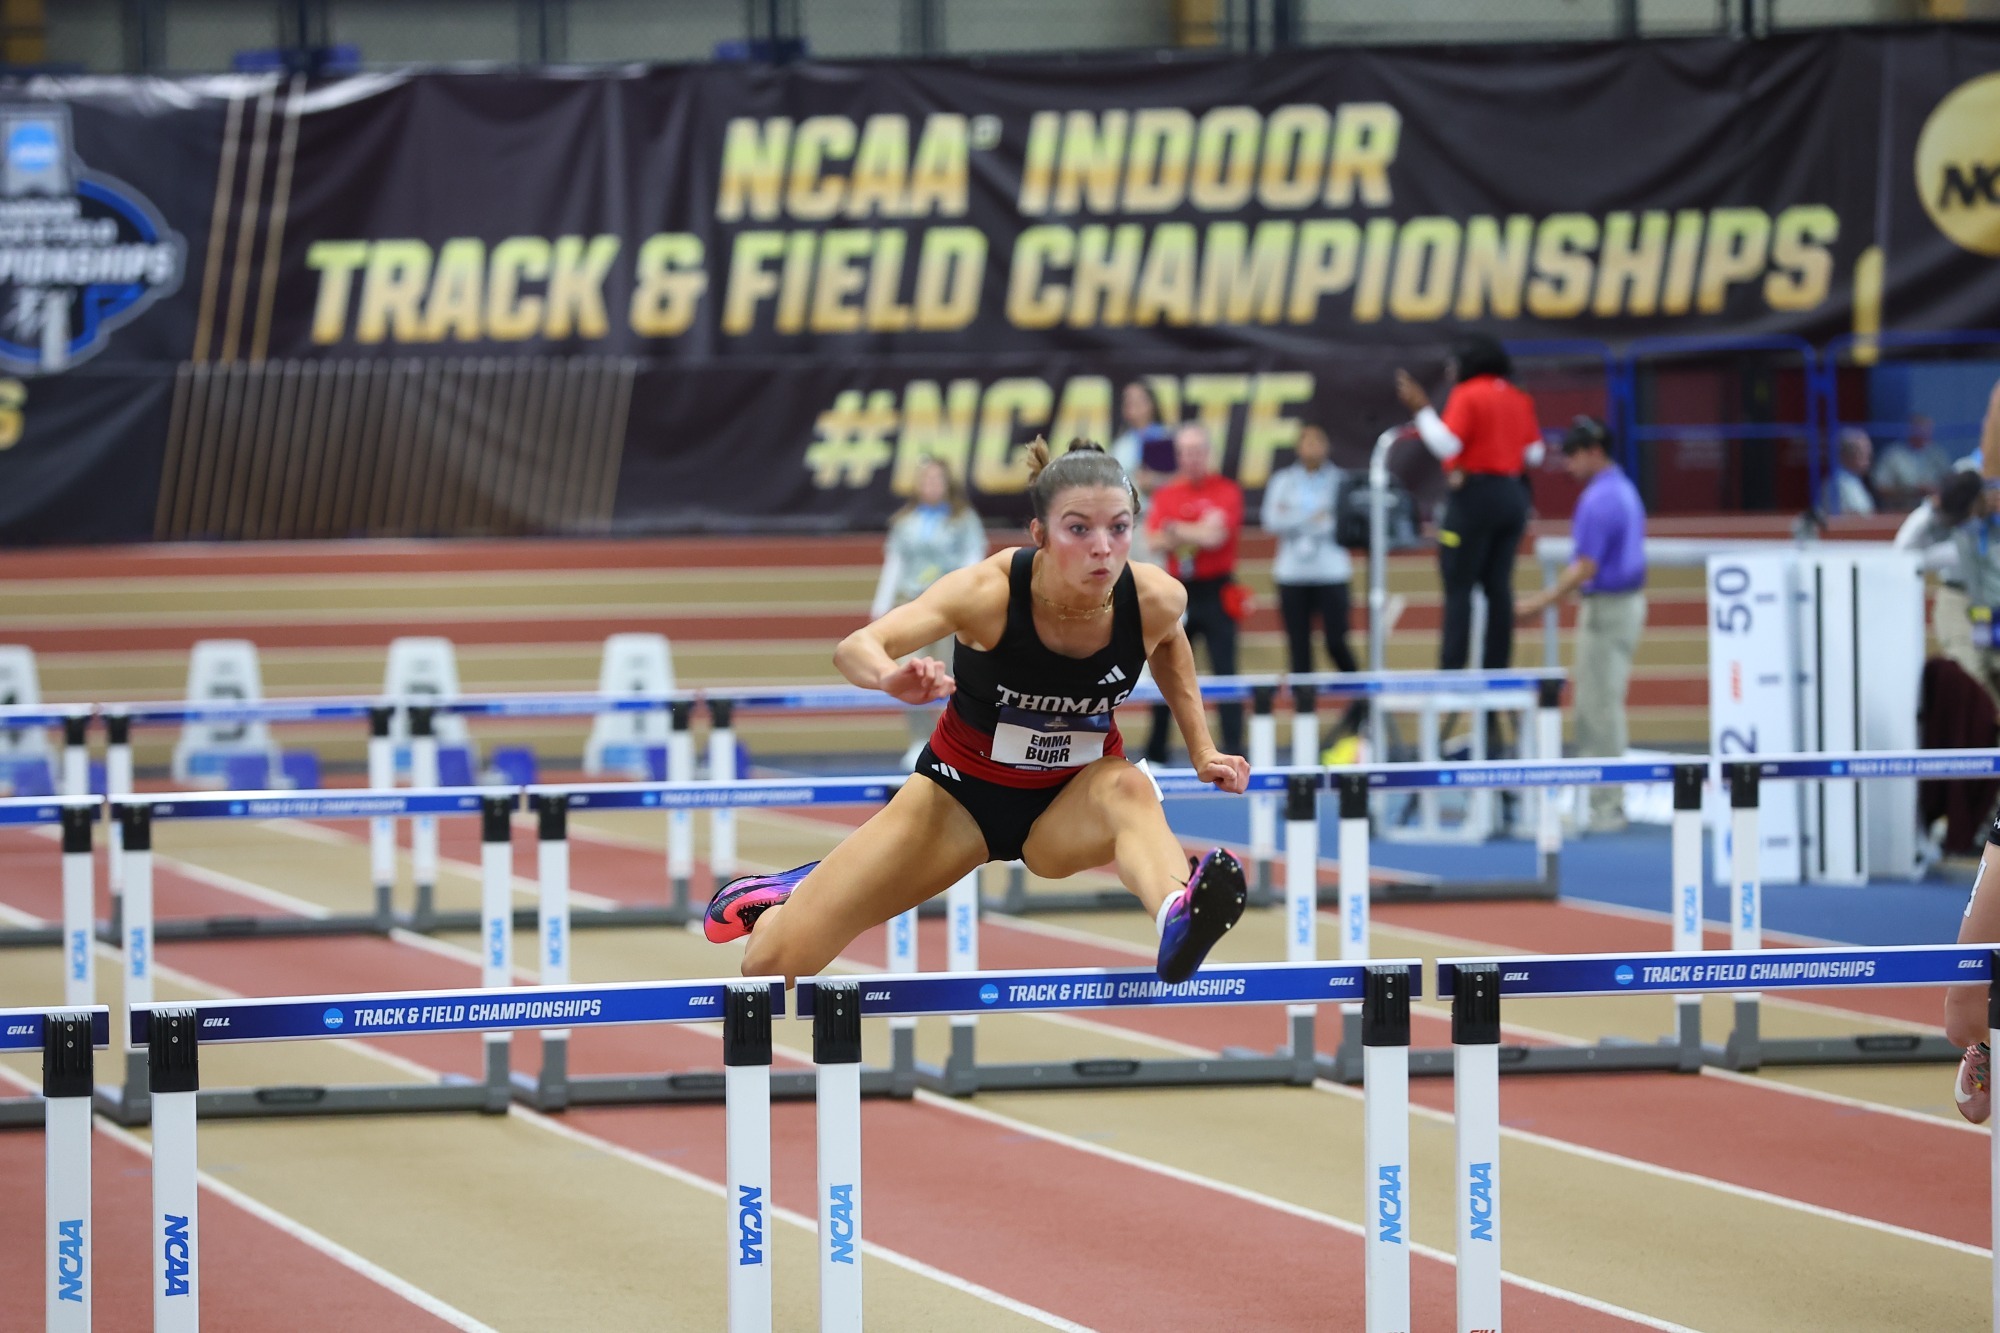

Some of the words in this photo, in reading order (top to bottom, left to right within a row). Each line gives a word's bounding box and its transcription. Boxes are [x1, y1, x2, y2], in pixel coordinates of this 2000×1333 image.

[1016, 101, 1401, 214] INDOOR
[306, 234, 620, 345] TRACK
[630, 232, 707, 337] &
[722, 225, 988, 335] FIELD
[1006, 204, 1840, 330] CHAMPIONSHIPS
[806, 371, 1315, 495] #NCATF
[996, 684, 1130, 715] THOMAS
[1030, 734, 1071, 748] EMMA
[1025, 746, 1070, 764] BURR
[1503, 972, 1529, 982] GILL
[1642, 965, 1690, 984] TRACK
[1693, 964, 1704, 982] &
[1706, 963, 1746, 982] FIELD
[1750, 960, 1876, 981] CHAMPIONSHIPS
[1958, 959, 1983, 969] GILL
[1008, 984, 1057, 1002] TRACK
[1059, 983, 1071, 1000] &
[1073, 982, 1114, 1000] FIELD
[1118, 978, 1246, 999] CHAMPIONSHIPS
[1329, 977, 1355, 986] GILL
[688, 996, 715, 1006] GILL
[865, 991, 891, 1001] GILL
[203, 1017, 231, 1028] GILL
[354, 1007, 404, 1027] TRACK
[407, 1006, 419, 1024] &
[421, 1005, 464, 1024] FIELD
[468, 999, 602, 1022] CHAMPIONSHIPS
[7, 1024, 34, 1035] GILL
[1379, 1165, 1401, 1244] NCAA
[1470, 1162, 1493, 1242] NCAA
[739, 1185, 762, 1266] NCAA
[831, 1184, 854, 1265] NCAA
[59, 1219, 83, 1303] NCAA
[165, 1213, 189, 1296] NCAA
